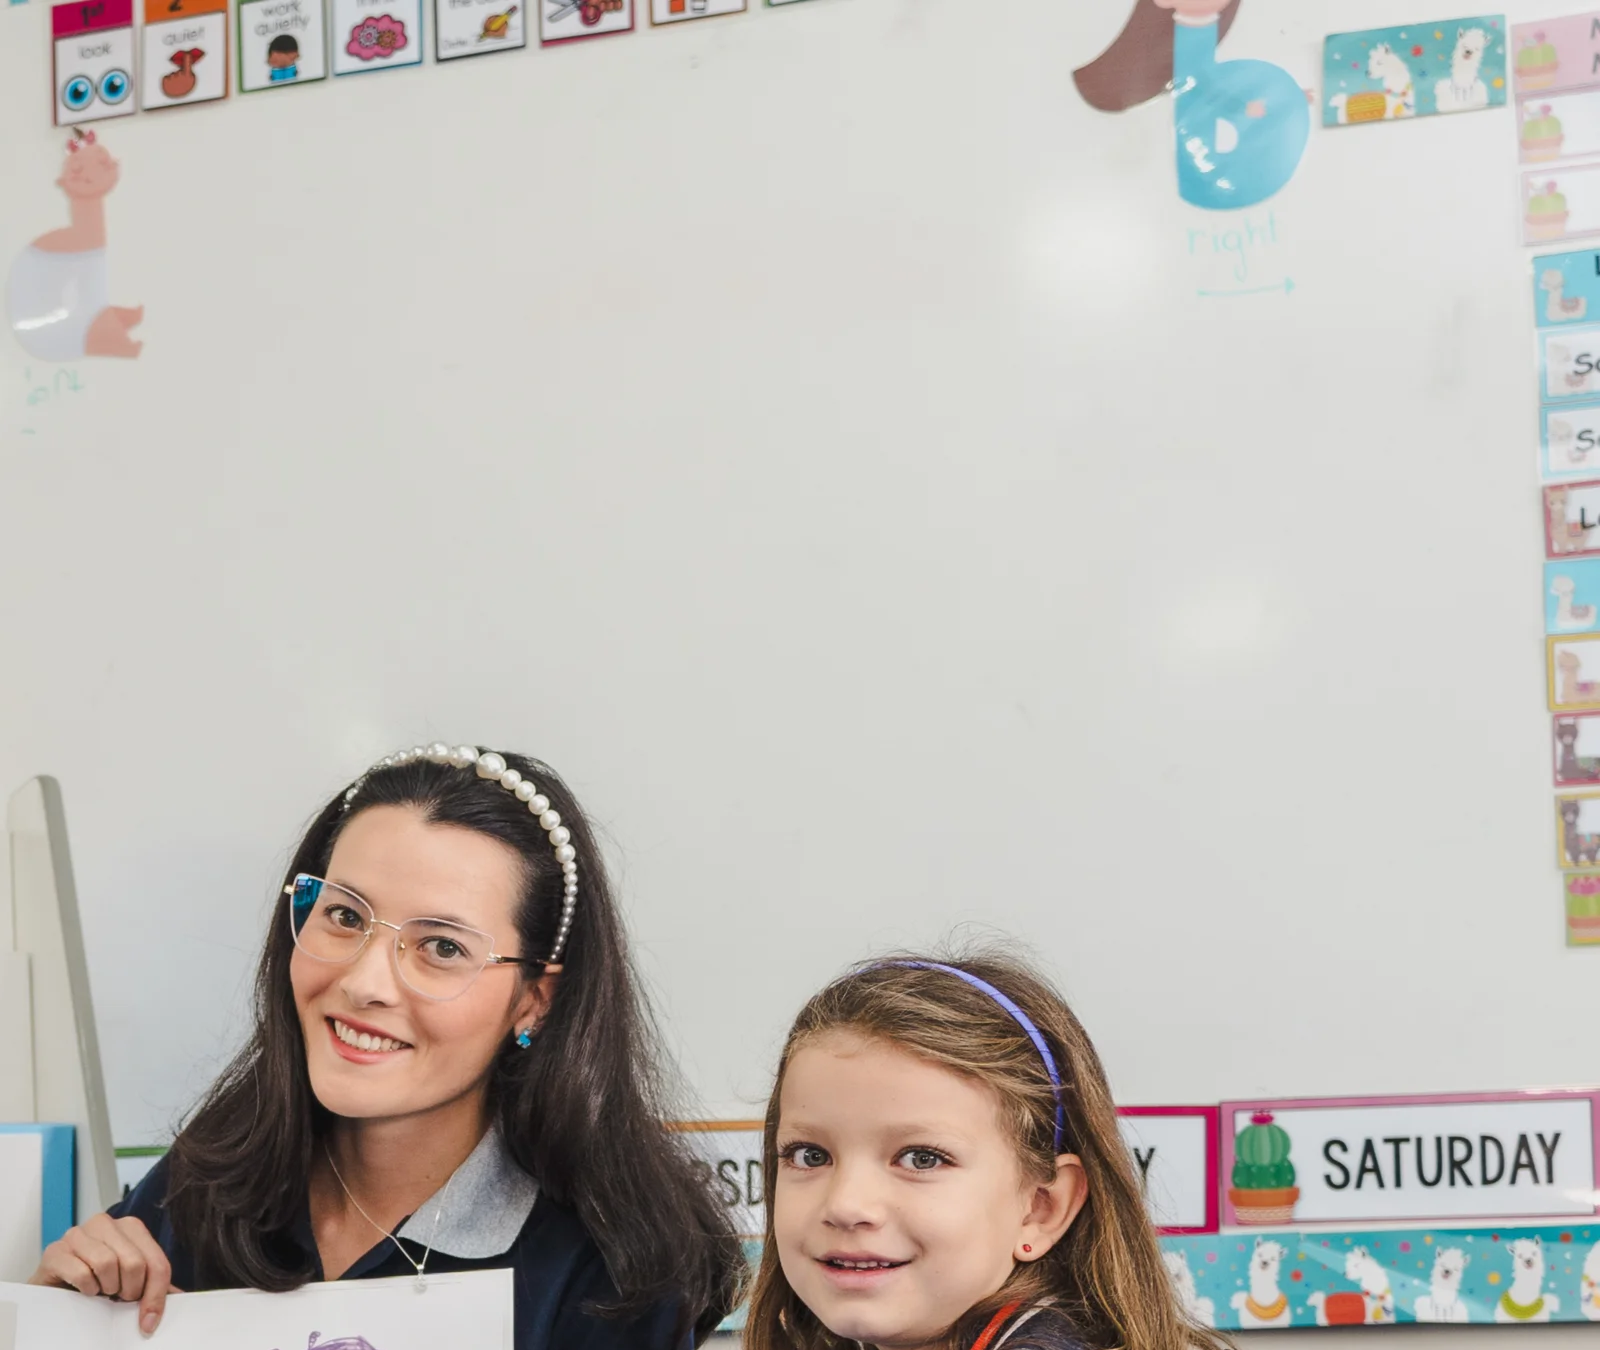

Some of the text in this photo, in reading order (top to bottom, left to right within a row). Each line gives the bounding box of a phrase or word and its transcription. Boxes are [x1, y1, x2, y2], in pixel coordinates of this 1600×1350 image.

[78, 42, 112, 61] look
[1185, 210, 1284, 284] right
[1321, 1131, 1564, 1193] SATURDAY
